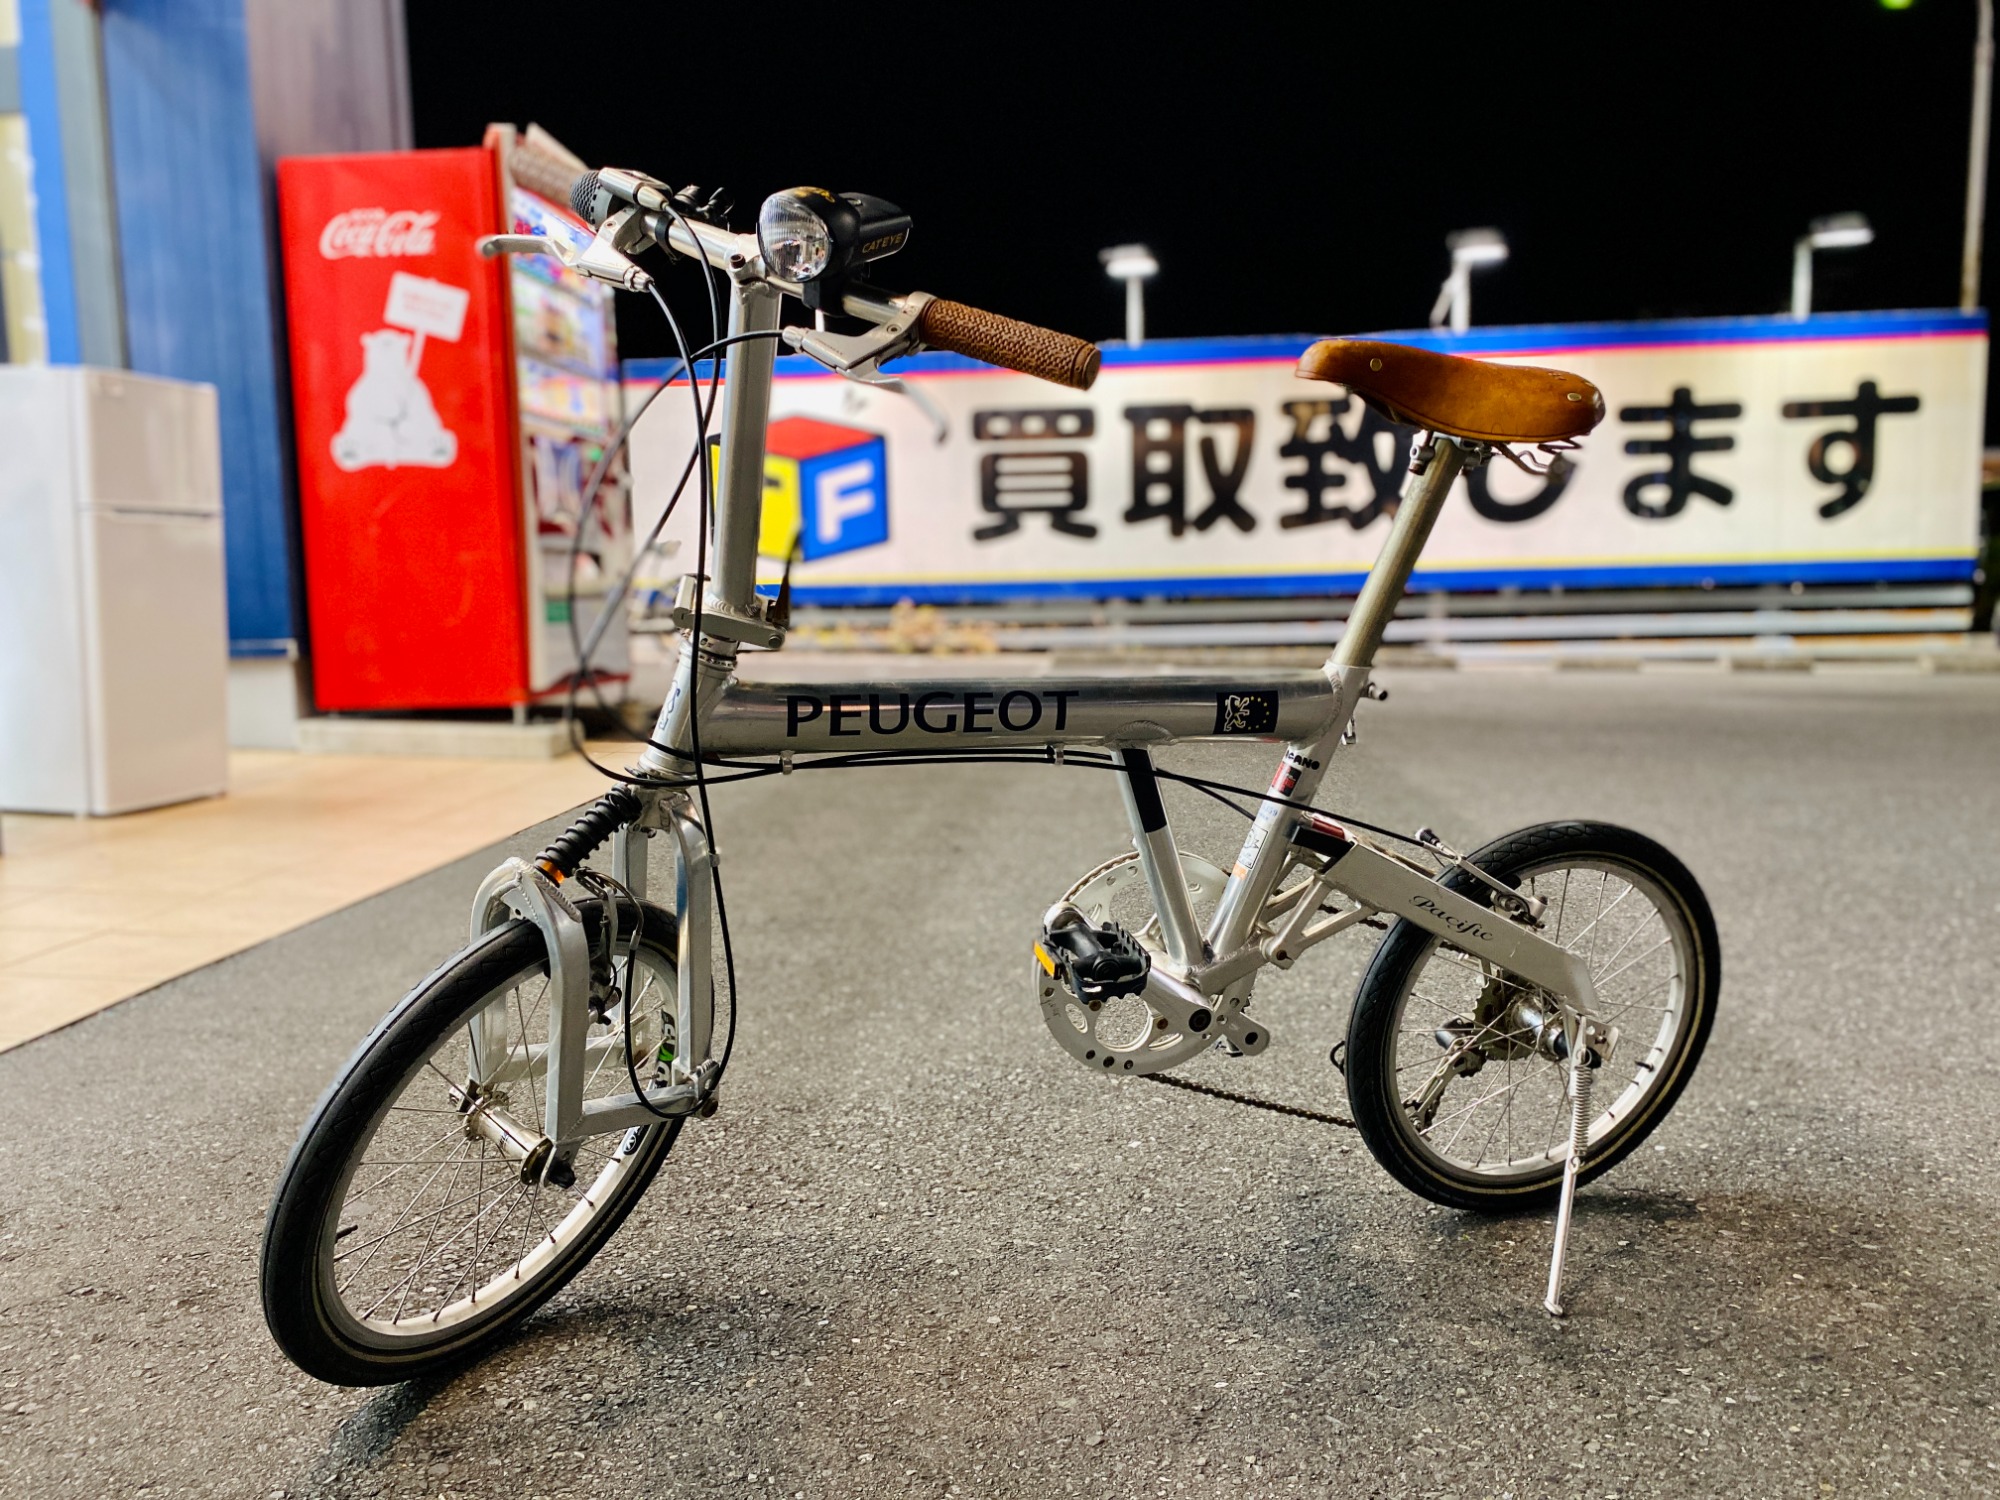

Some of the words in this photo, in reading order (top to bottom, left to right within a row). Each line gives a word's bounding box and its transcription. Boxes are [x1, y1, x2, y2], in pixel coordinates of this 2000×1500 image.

[862, 233, 904, 253] CATEYE
[786, 690, 1079, 737] PEUGEOT
[1409, 896, 1493, 940] Pacific
